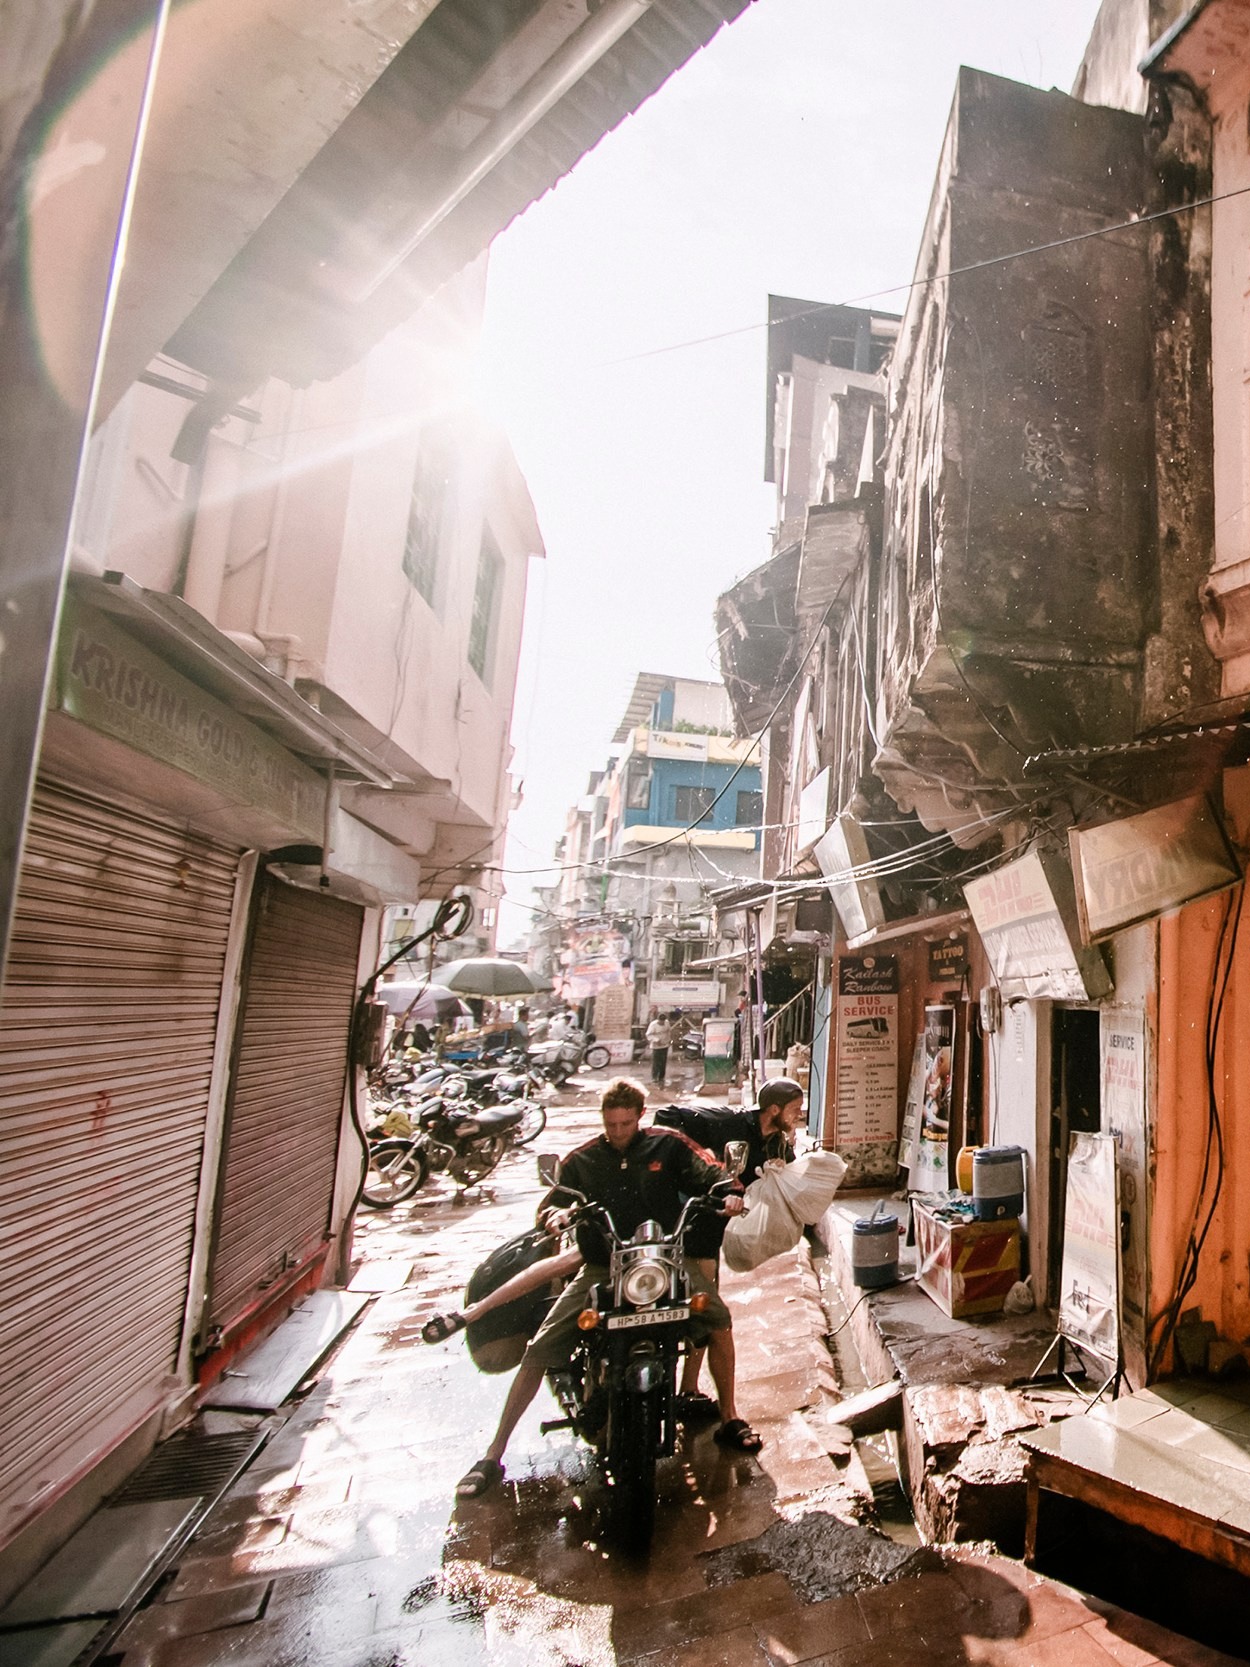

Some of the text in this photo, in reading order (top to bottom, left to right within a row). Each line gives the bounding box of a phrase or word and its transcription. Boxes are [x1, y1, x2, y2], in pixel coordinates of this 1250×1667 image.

[857, 996, 881, 1006] BUS
[843, 1005, 895, 1016] SERVICE
[1110, 1034, 1134, 1050] SERVICE
[617, 1316, 630, 1327] HP
[650, 1314, 656, 1323] A
